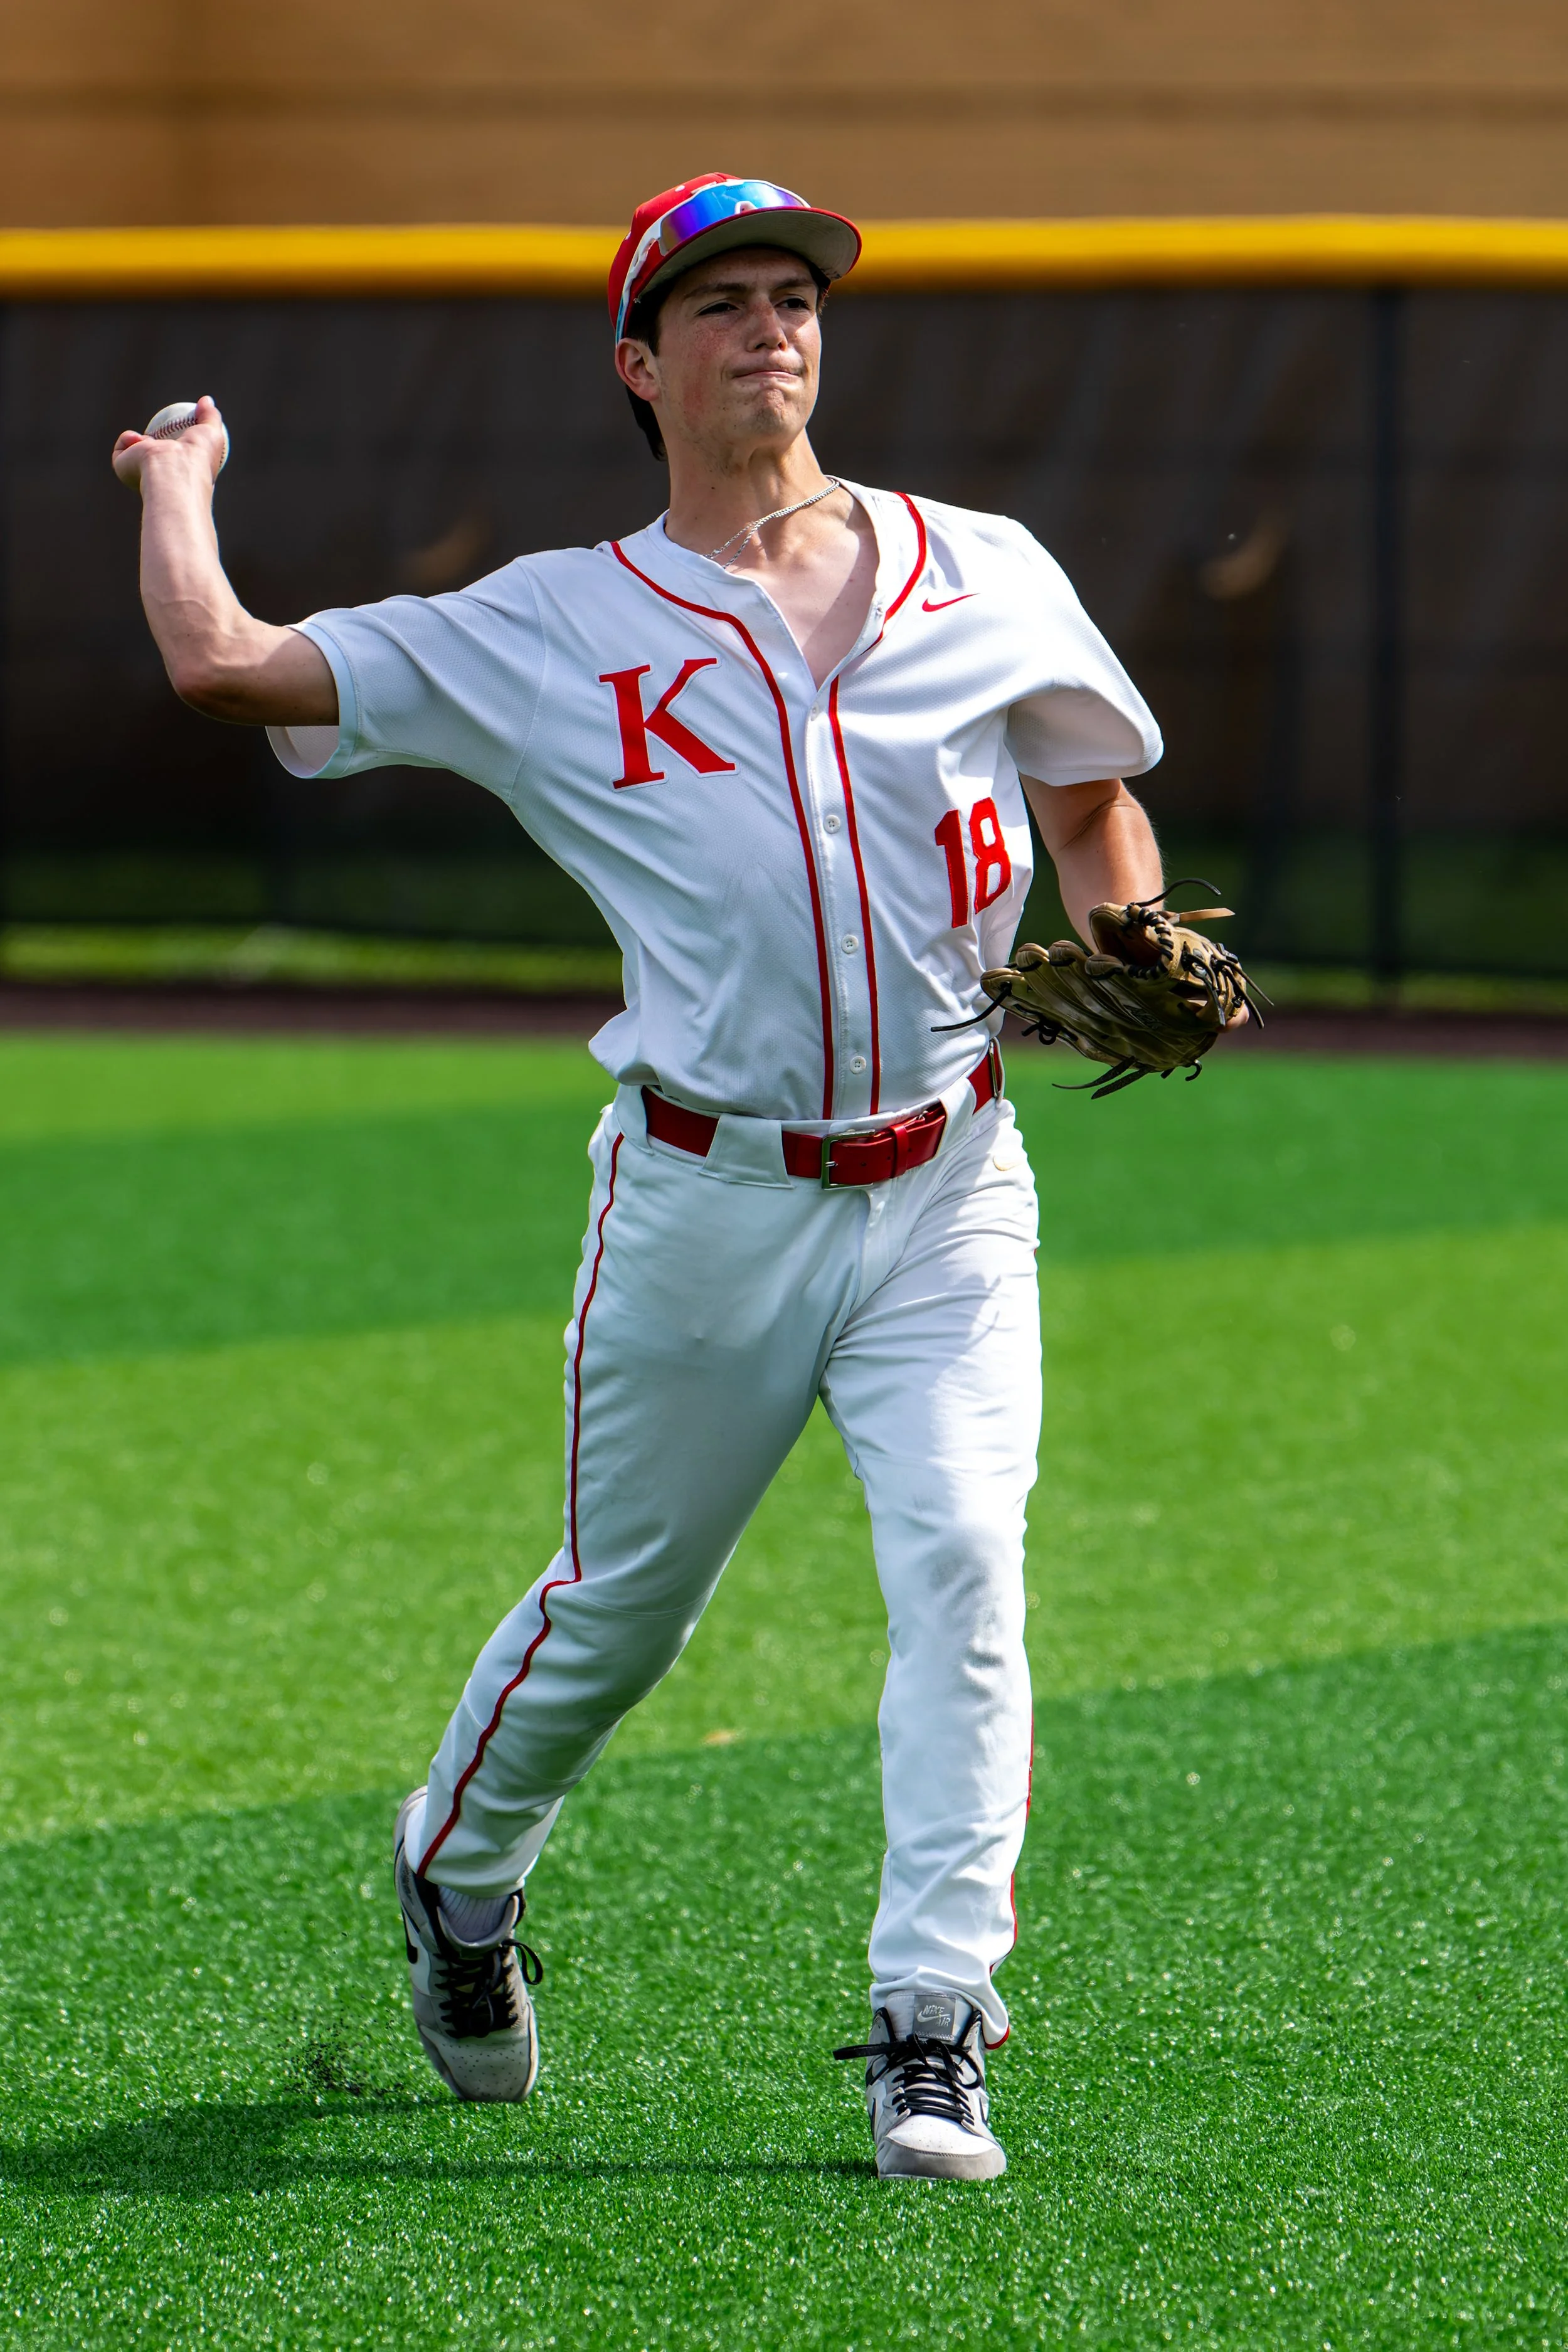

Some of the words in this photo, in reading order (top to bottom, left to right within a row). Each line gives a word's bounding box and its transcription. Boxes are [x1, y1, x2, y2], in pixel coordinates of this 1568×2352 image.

[598, 657, 736, 790] K
[935, 797, 1012, 928] 18
[922, 2005, 945, 2015] NIKE
